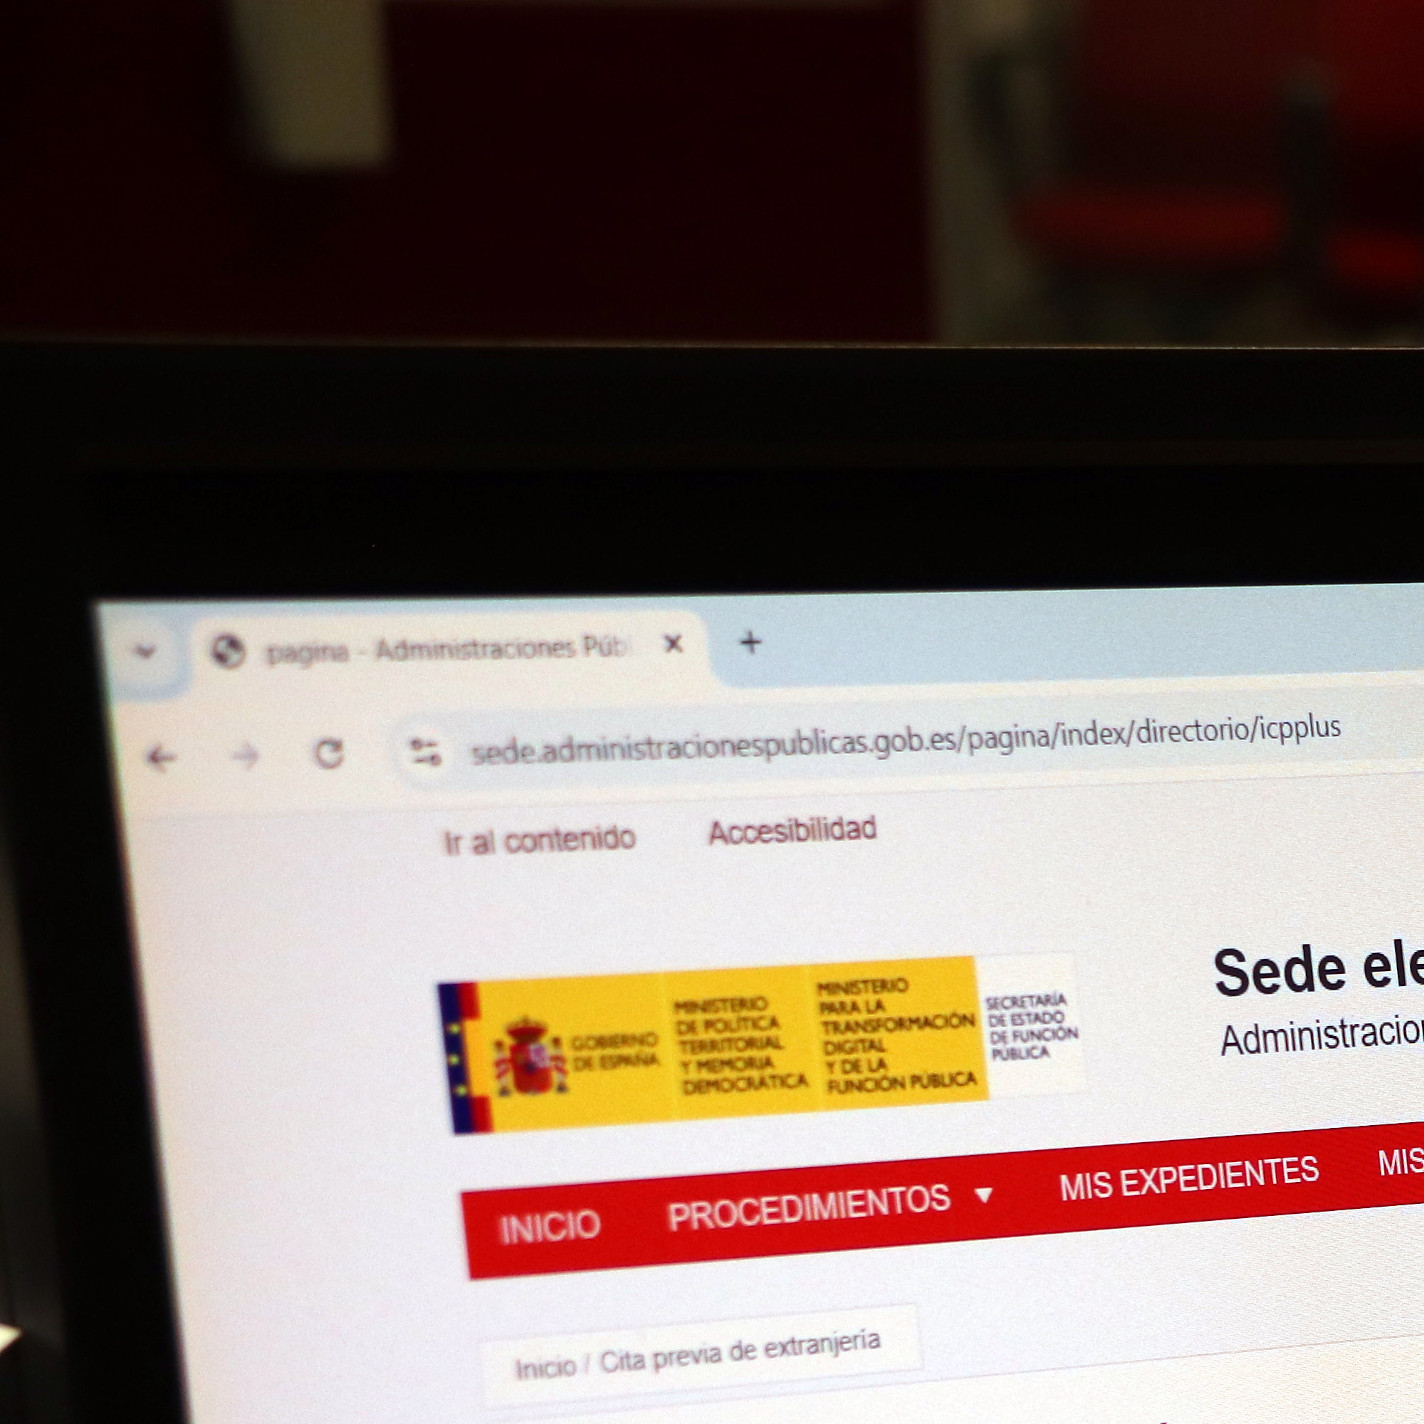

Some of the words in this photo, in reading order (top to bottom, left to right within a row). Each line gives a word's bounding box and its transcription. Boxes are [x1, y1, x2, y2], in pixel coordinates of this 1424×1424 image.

[470, 712, 1341, 766] sede.administracionespublicas.gob.es/pagina/index/directorio/icpplus
[444, 831, 463, 856] Ir
[472, 830, 496, 856] al
[503, 825, 637, 855] contenido
[708, 815, 877, 846] Accesibilidad
[1214, 943, 1347, 998] Sede
[986, 993, 1068, 1011] SECRETARÍA
[988, 1013, 1007, 1028] DE
[1009, 1009, 1066, 1027] ESTADO
[989, 1030, 1008, 1046] DE
[1011, 1025, 1080, 1044] FUNCIÓN
[991, 1044, 1051, 1062] PÚBLICA
[1059, 1171, 1113, 1201] MIS
[1119, 1155, 1320, 1197] EXPEDIENTES
[667, 1183, 952, 1232] PROCEDIMIENTOS
[499, 1208, 602, 1245] INICIO
